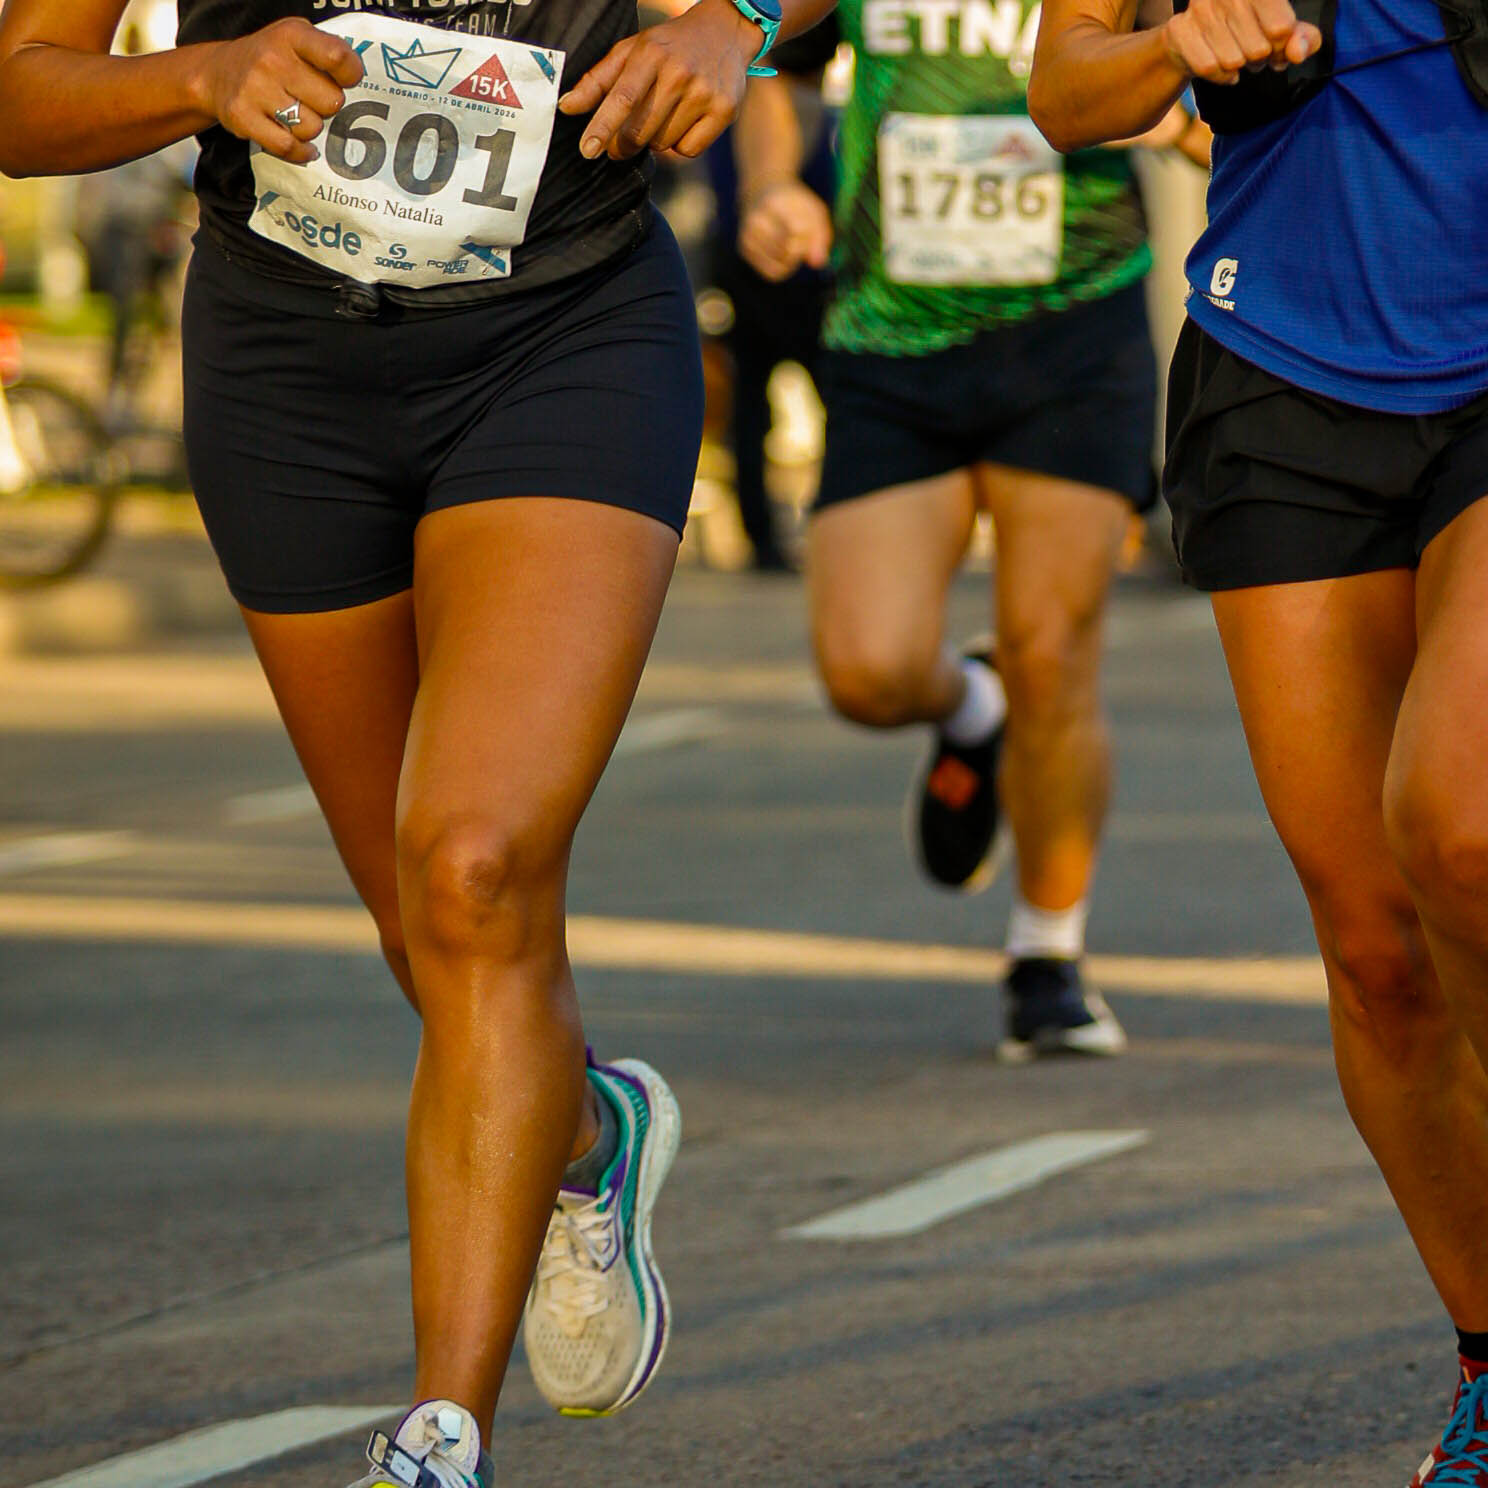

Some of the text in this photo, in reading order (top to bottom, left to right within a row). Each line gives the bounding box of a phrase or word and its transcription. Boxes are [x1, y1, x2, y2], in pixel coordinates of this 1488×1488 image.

[389, 86, 429, 101] ROSARIO
[438, 95, 448, 105] 12
[451, 99, 463, 108] DE
[465, 102, 491, 114] ABRIL
[494, 108, 516, 119] 2026
[469, 74, 508, 100] 15K
[302, 100, 518, 212] 601
[312, 184, 444, 226] Alfonso Natalia
[894, 171, 1050, 220] 1786
